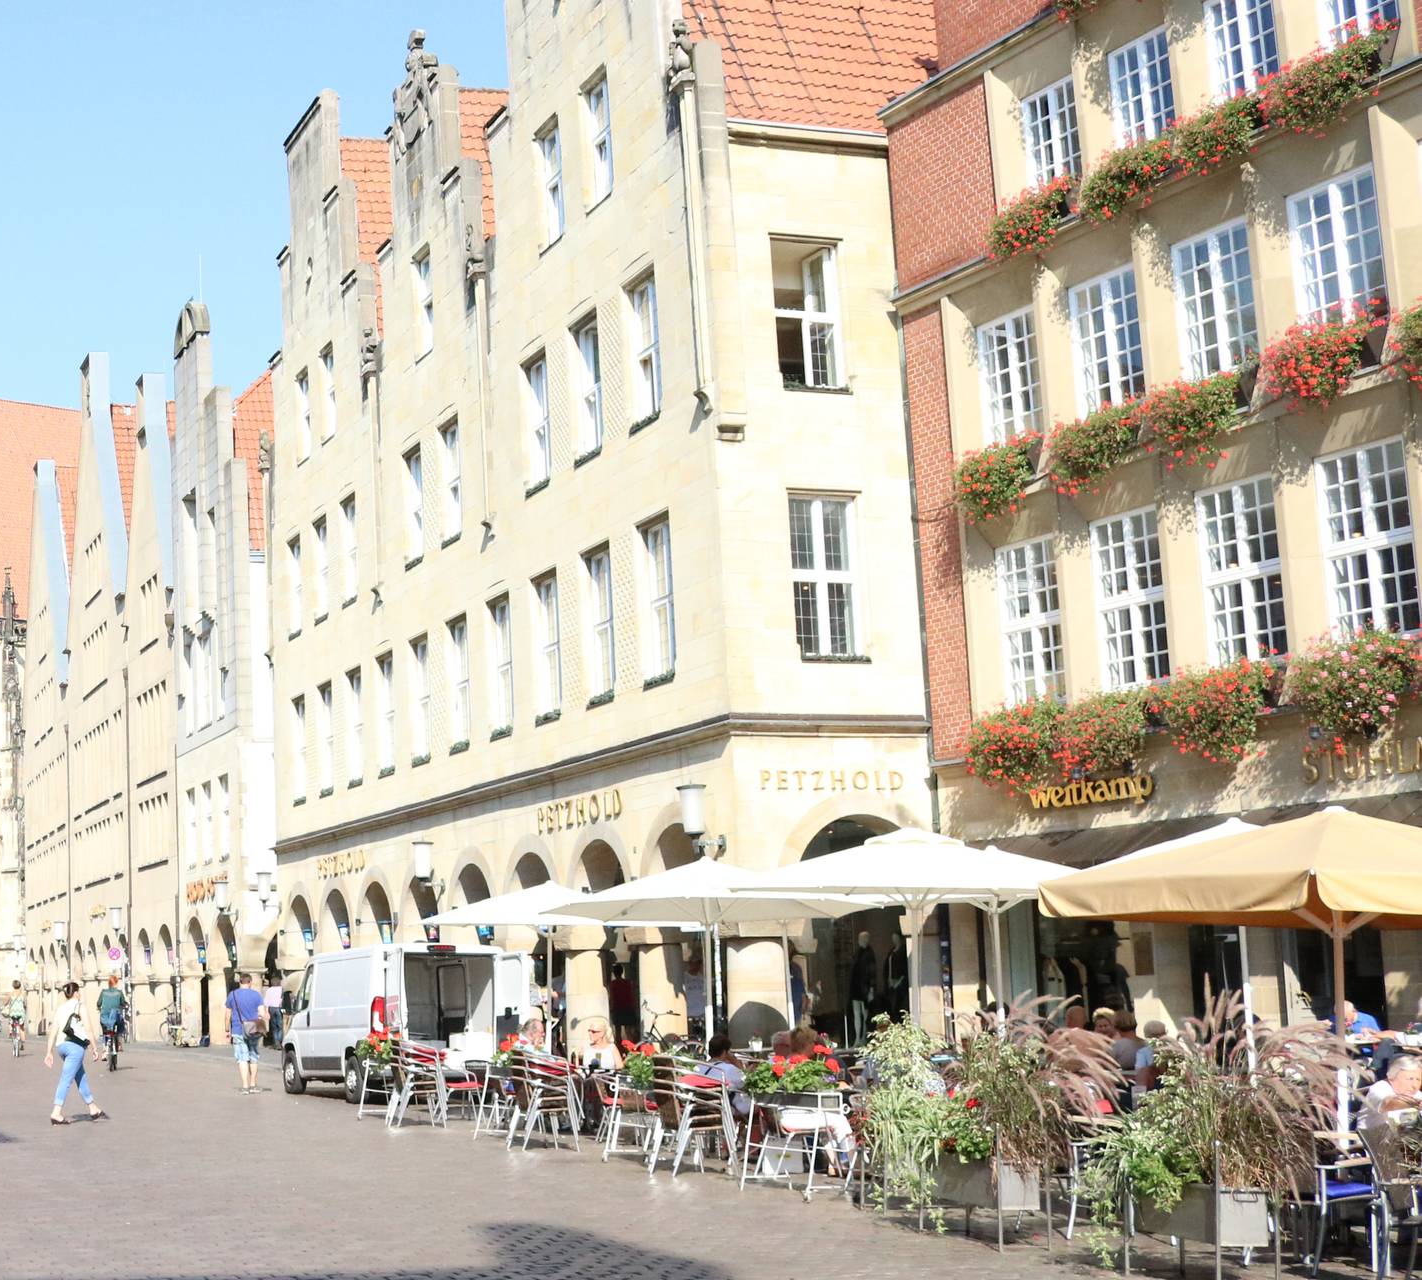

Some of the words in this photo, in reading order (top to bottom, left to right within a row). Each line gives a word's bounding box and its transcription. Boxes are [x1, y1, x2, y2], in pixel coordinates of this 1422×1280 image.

[1301, 736, 1422, 785] STUHL
[759, 769, 904, 791] PETZHOLD
[1029, 774, 1154, 810] weitkamp
[538, 788, 623, 835] PETZHOLD
[316, 848, 367, 880] PETZHOLD
